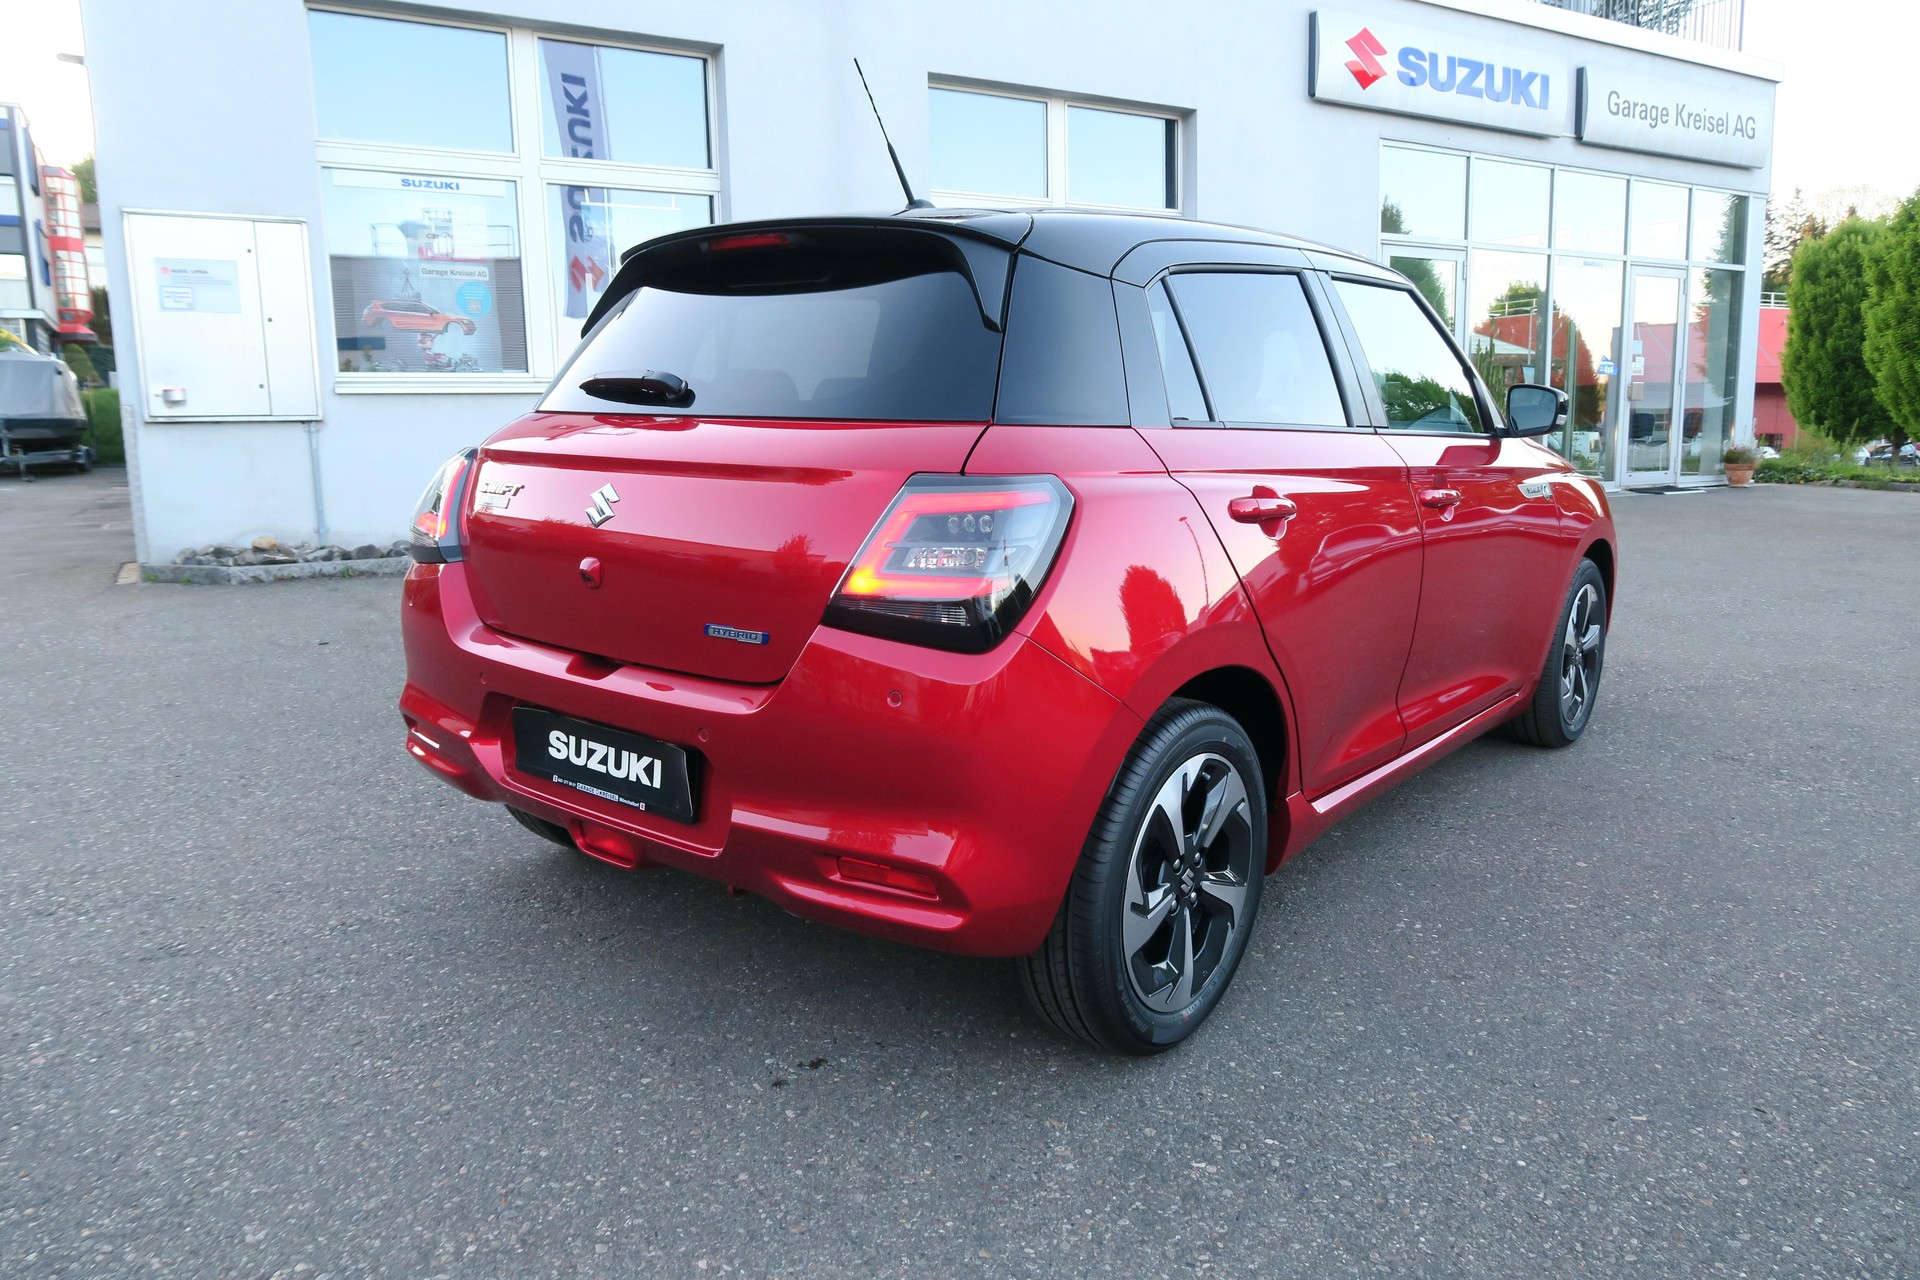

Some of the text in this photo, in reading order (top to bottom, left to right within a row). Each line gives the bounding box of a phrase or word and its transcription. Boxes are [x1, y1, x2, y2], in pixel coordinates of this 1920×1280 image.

[1396, 46, 1550, 110] SUZUKI
[1607, 90, 1756, 140] Garage Kreisel AG
[401, 178, 460, 191] SUZUKI
[421, 267, 487, 278] Garage Kreisel AG
[712, 627, 758, 640] HYBRID
[548, 730, 662, 789] SUZUKI
[577, 783, 595, 794] GARAGE
[599, 789, 618, 801] KREISEL
